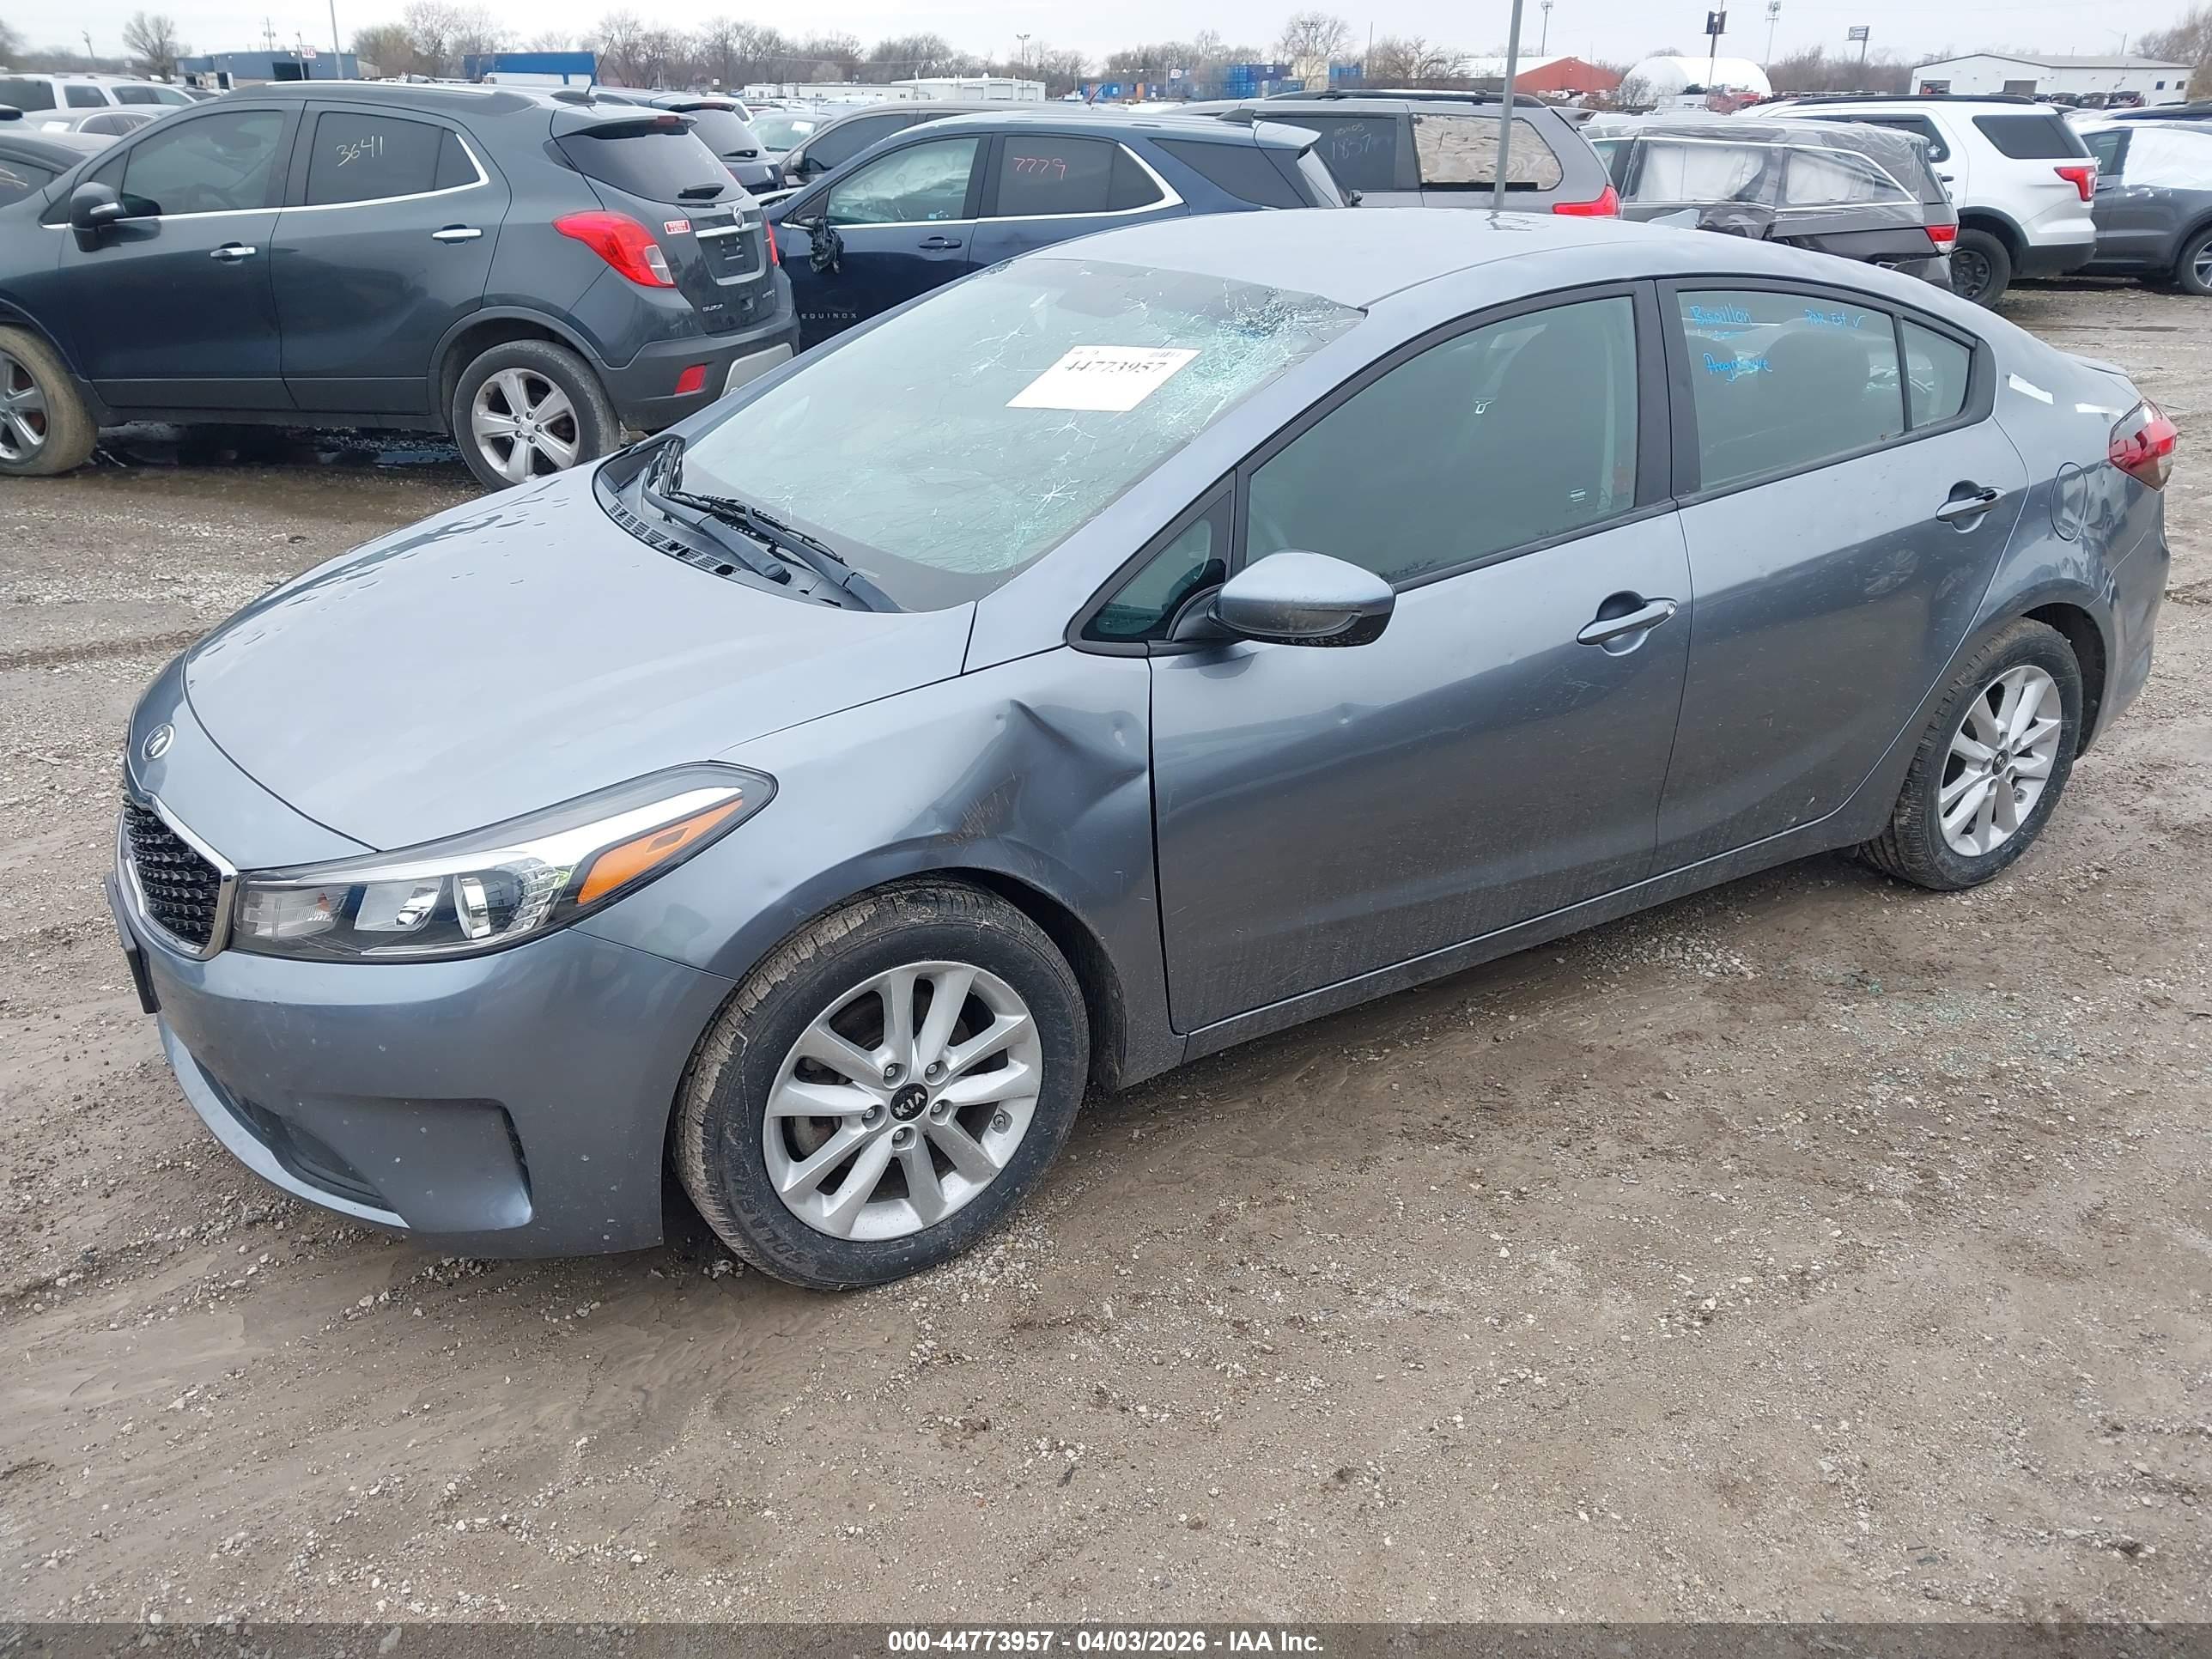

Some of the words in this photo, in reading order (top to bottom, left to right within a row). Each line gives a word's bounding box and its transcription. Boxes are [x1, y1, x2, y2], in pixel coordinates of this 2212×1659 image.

[336, 135, 383, 167] 3641
[1012, 157, 1066, 181] 7779
[1065, 361, 1168, 373] 44773957
